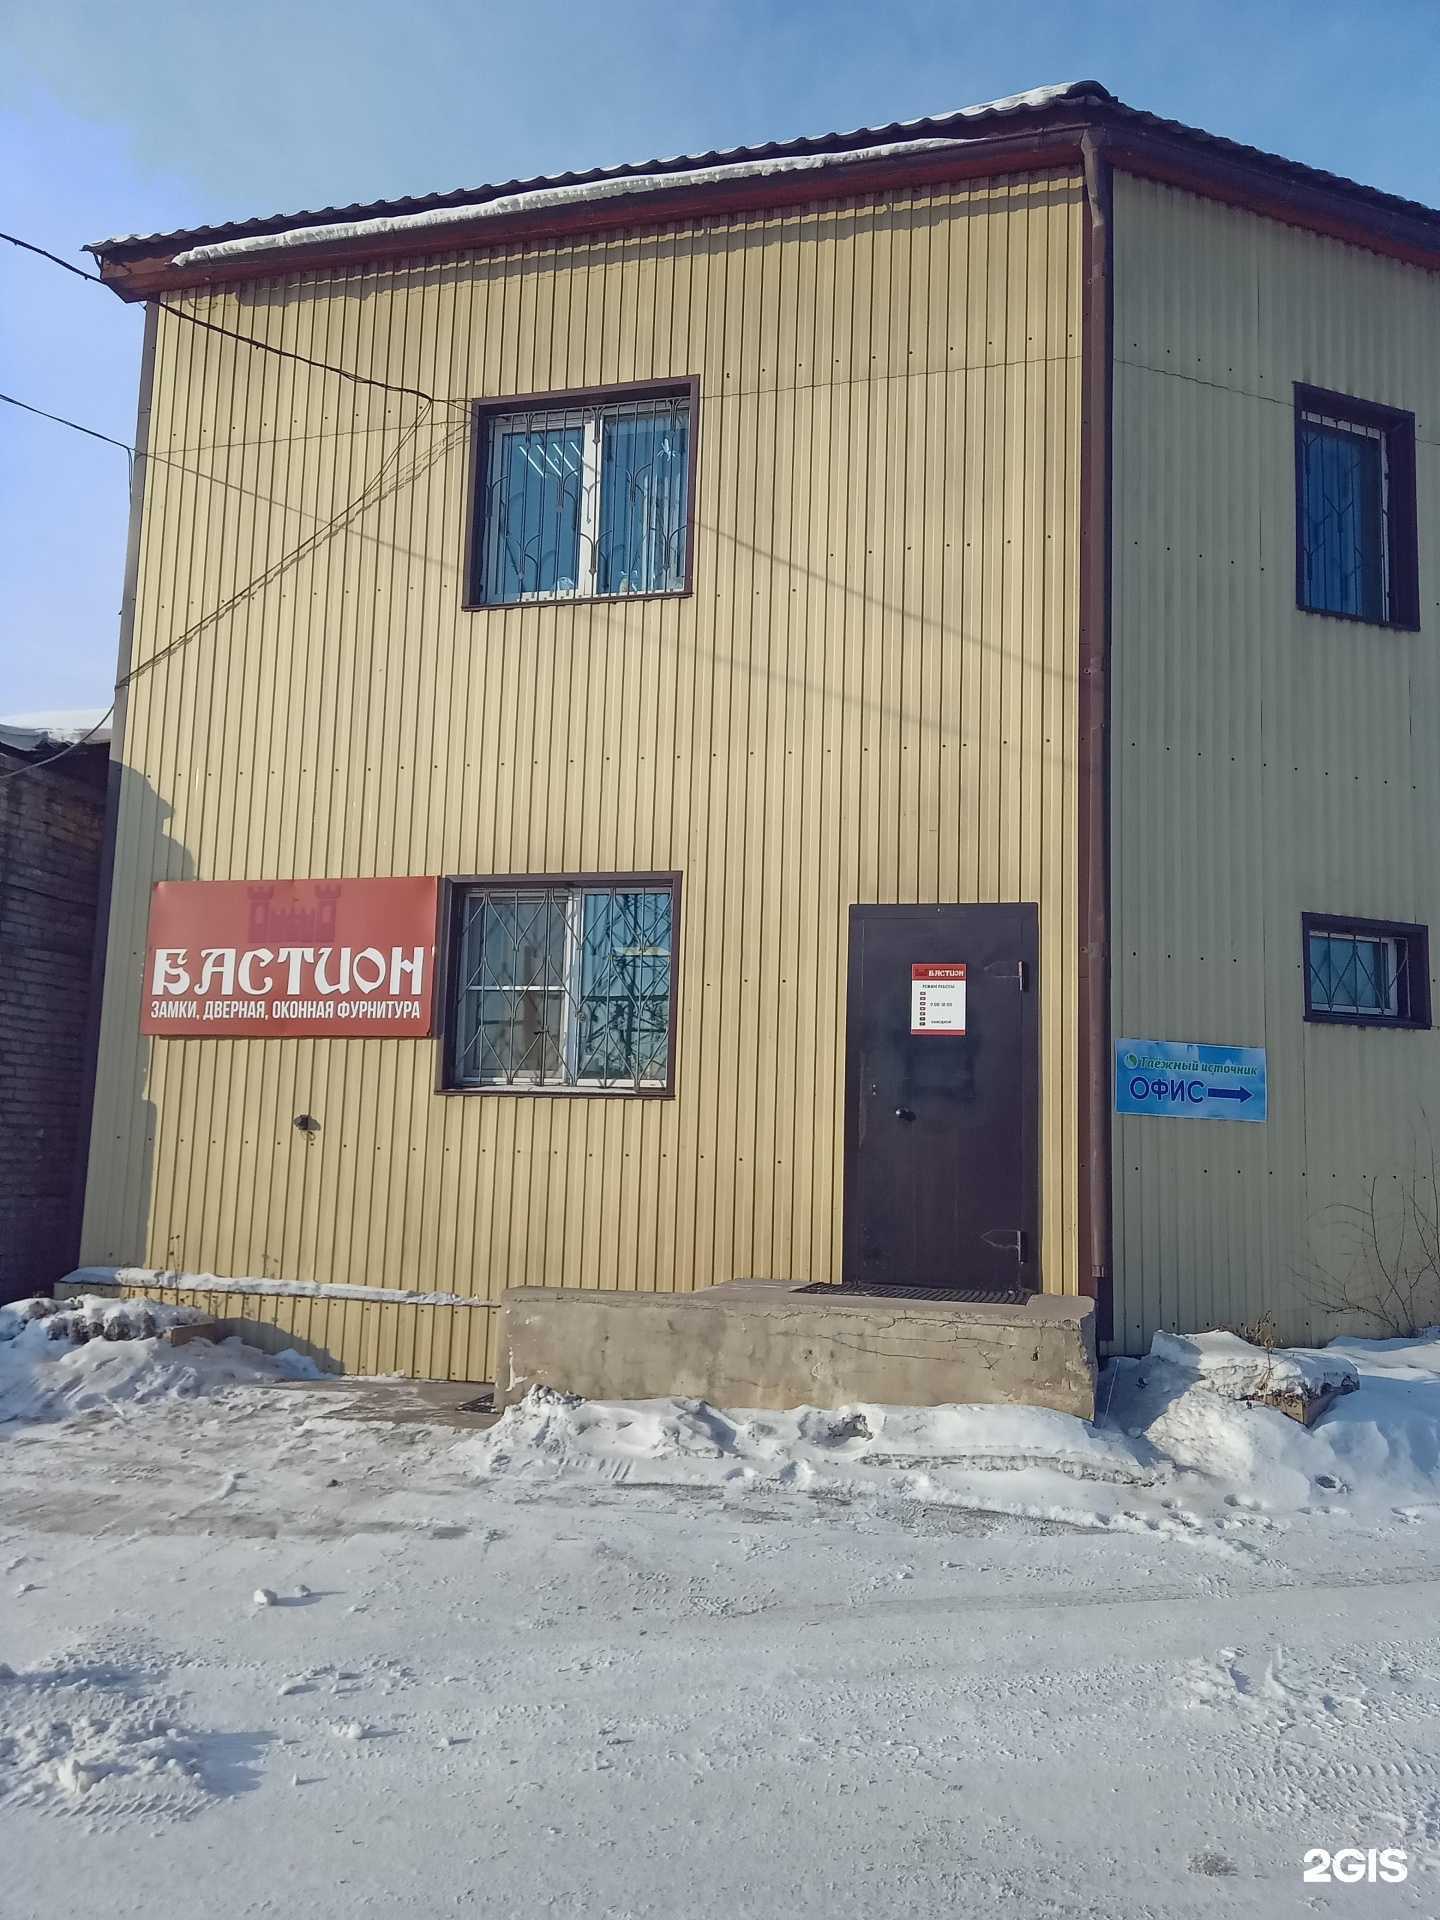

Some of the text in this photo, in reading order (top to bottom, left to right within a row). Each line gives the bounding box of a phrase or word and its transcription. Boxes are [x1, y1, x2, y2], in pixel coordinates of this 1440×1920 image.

[151, 946, 424, 996] БАСТИОН
[150, 1000, 421, 1021] ЗАМКИ, ДВЕРНАЯ, ОКОННАЯ ФУРНИТУРА
[1201, 1062, 1257, 1075] источник
[1129, 1076, 1205, 1103] ОФИС
